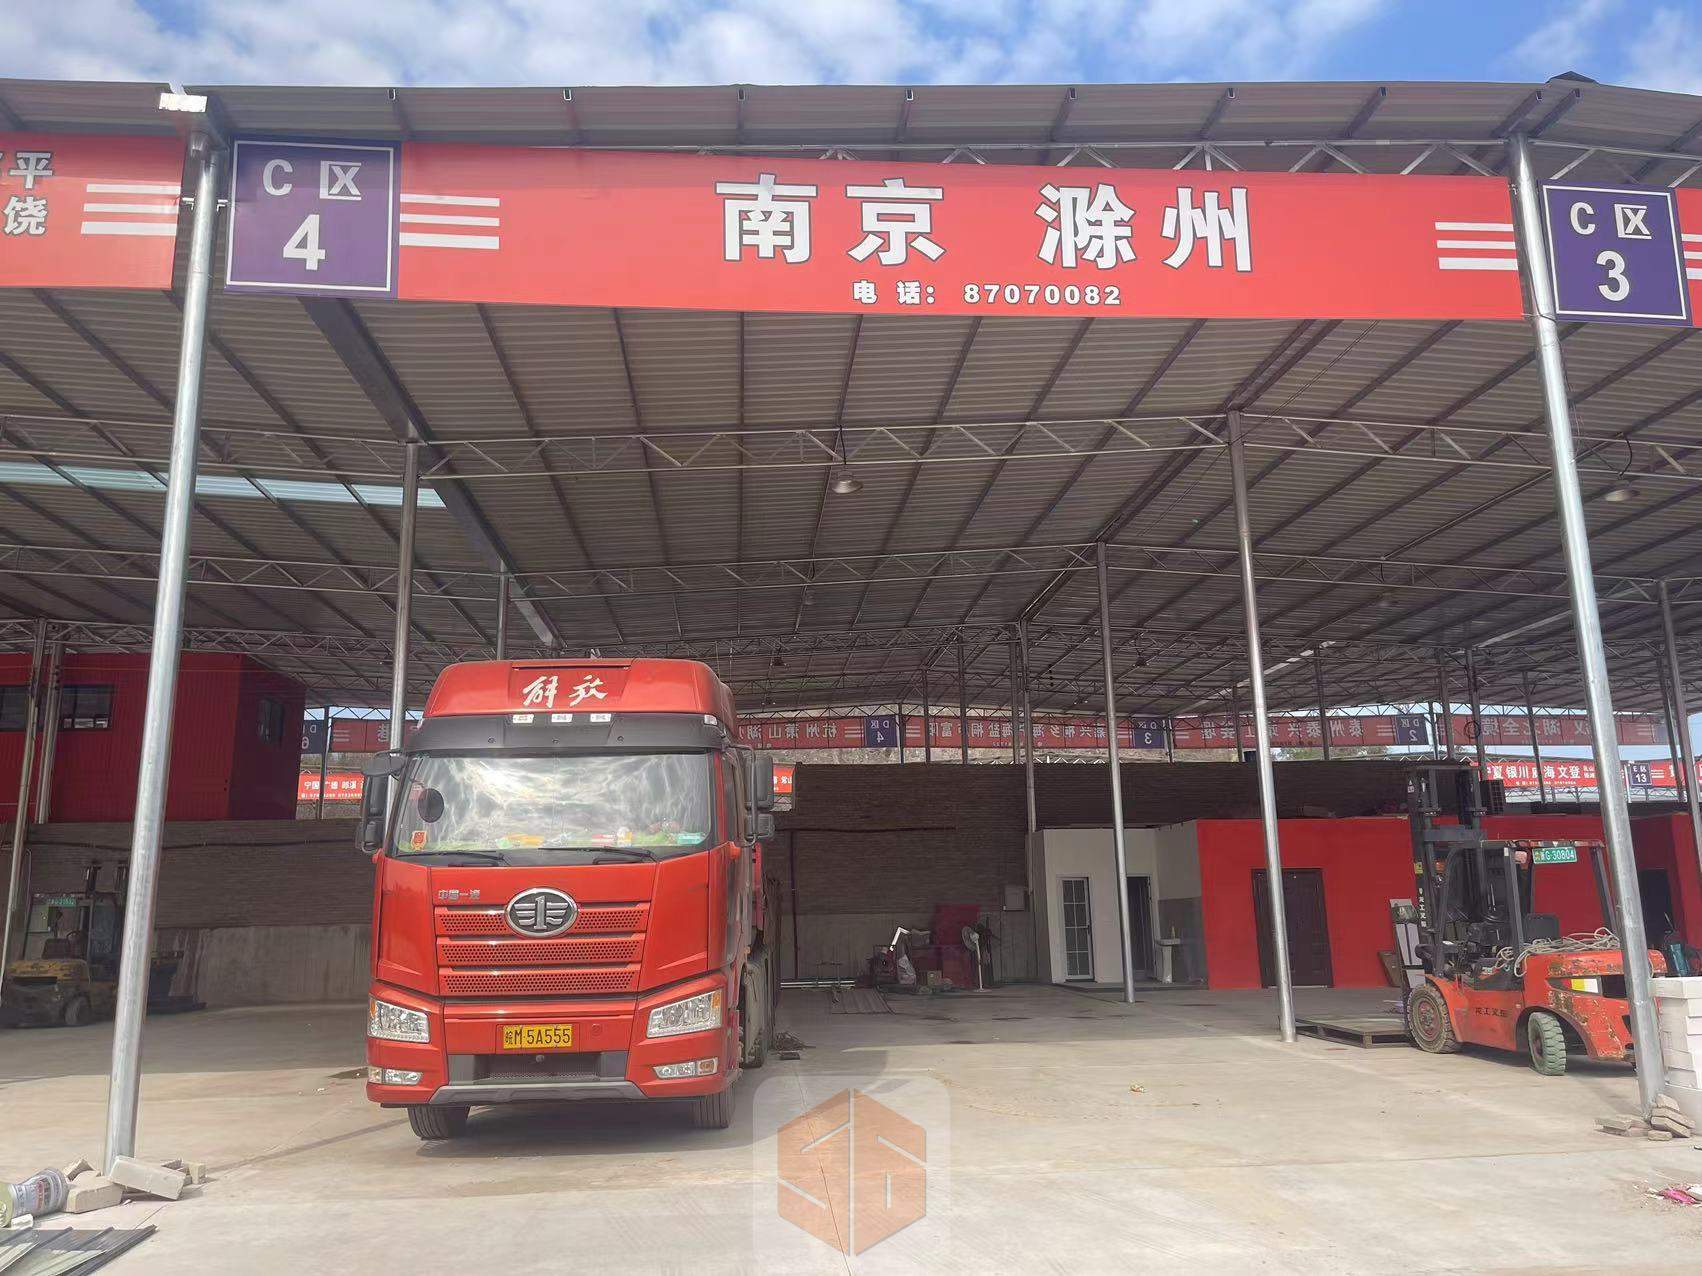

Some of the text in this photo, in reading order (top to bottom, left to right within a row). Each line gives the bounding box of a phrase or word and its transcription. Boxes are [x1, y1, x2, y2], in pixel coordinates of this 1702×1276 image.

[0, 151, 53, 189] 平
[3, 196, 48, 236] 饶
[714, 173, 1252, 272] 南京 滁州
[282, 213, 326, 271] 4
[963, 283, 1122, 306] 87070082
[1596, 251, 1630, 301] 3
[1635, 773, 1647, 782] 13
